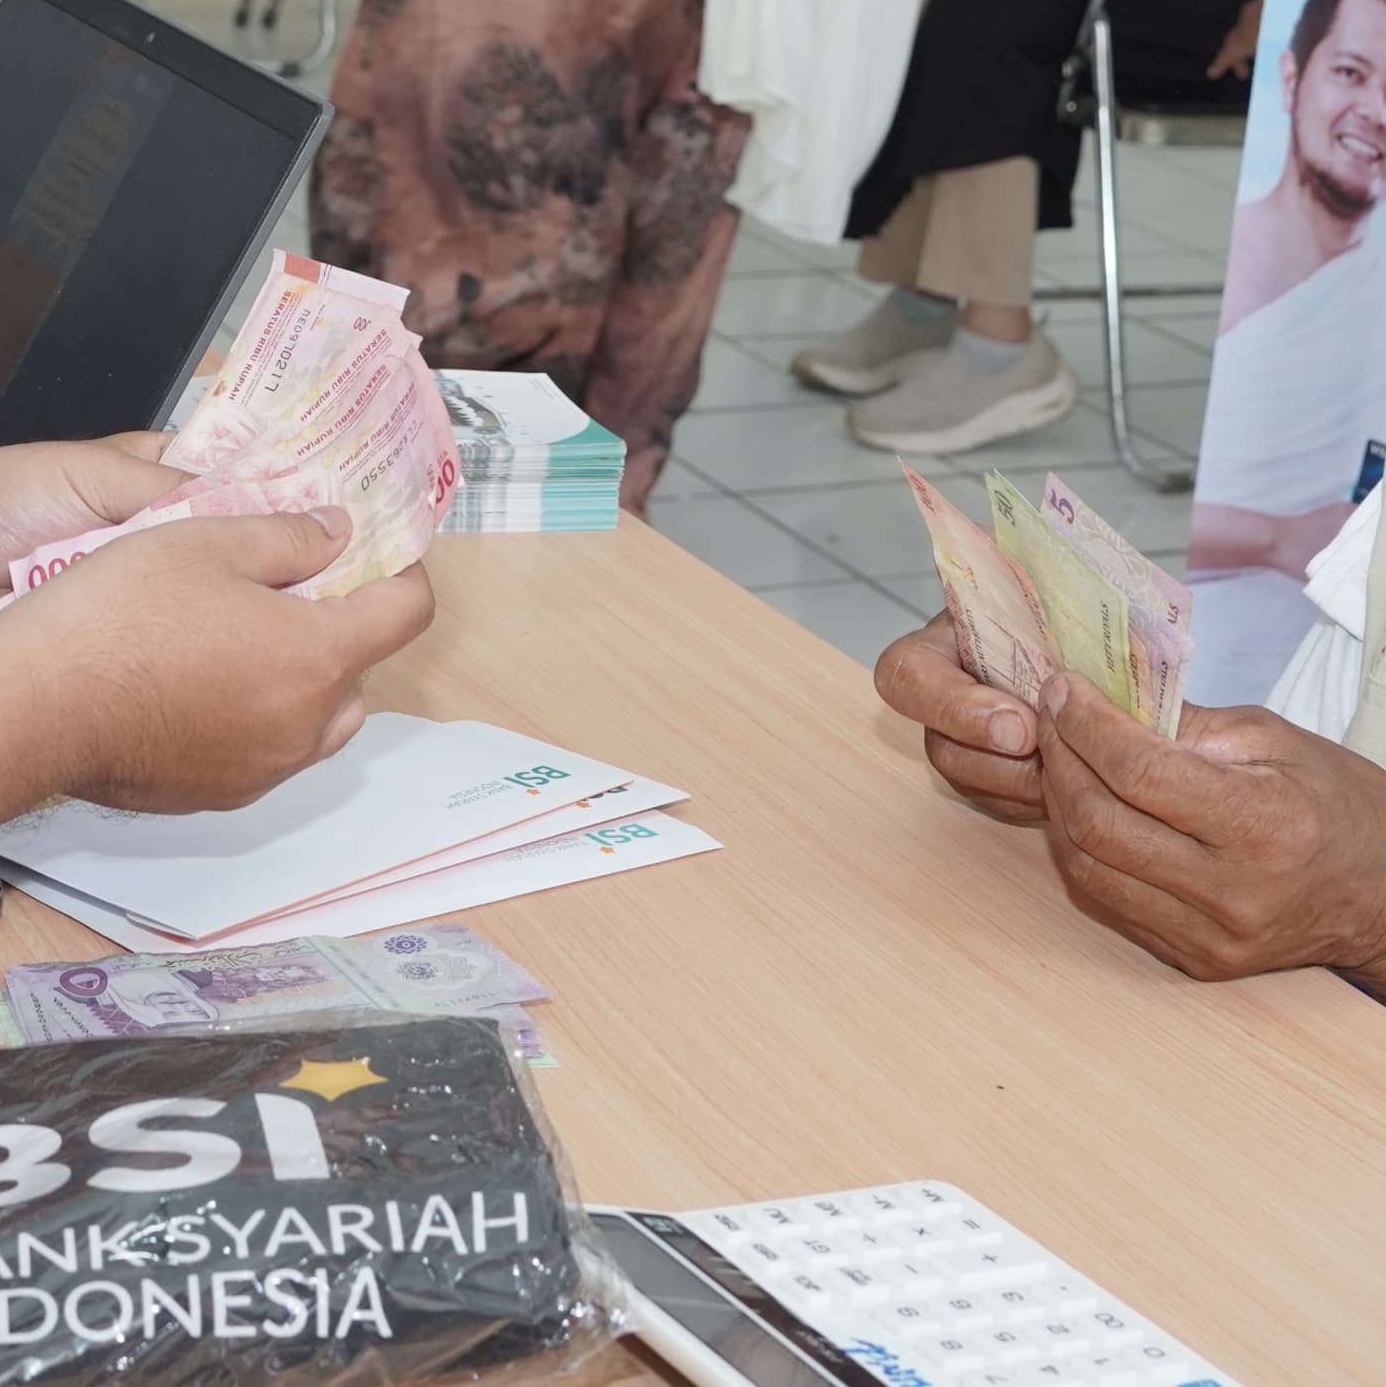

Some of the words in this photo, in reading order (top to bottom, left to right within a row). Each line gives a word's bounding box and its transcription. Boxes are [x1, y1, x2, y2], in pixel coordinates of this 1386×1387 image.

[503, 765, 572, 788] BSI
[584, 823, 660, 847] BSI
[163, 1191, 530, 1264] SYARIAH
